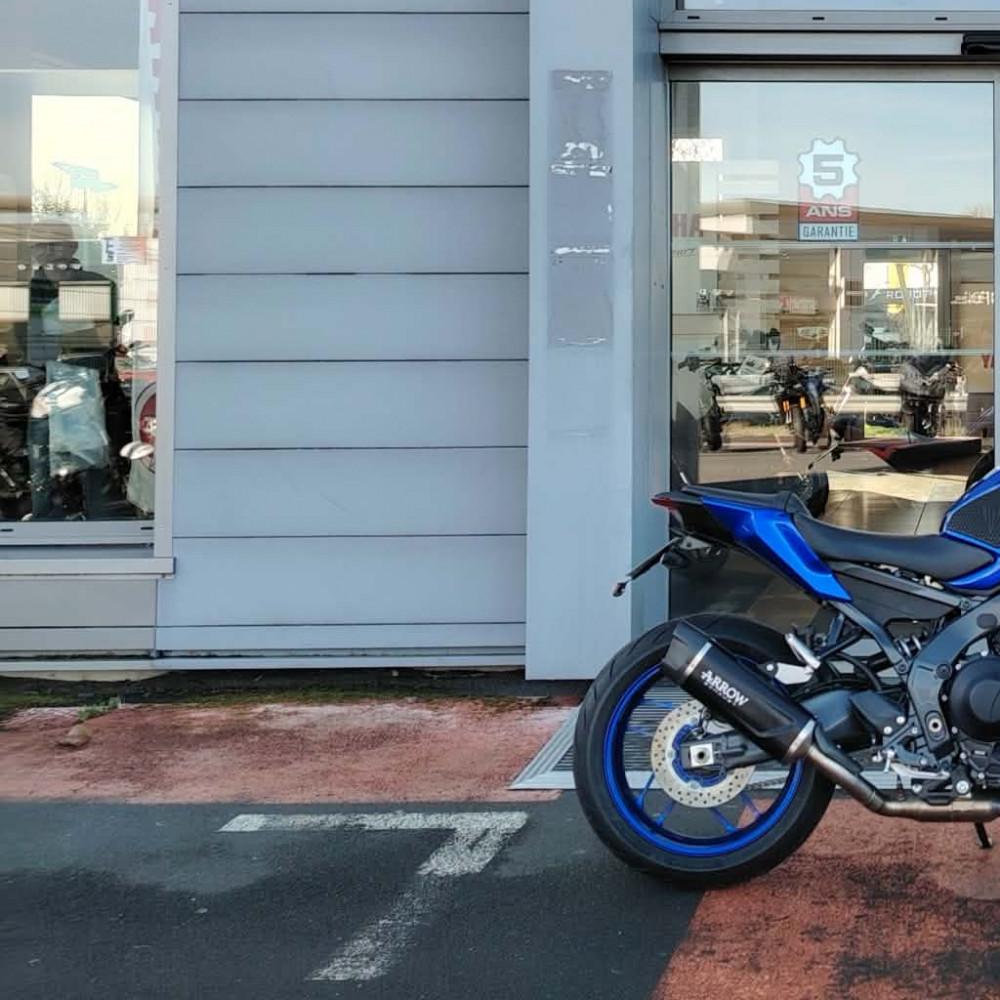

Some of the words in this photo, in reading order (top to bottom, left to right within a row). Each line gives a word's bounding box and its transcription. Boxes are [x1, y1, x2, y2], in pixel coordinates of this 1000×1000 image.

[813, 154, 844, 186] 5
[805, 205, 852, 218] ANS
[803, 226, 856, 238] GARANTIE
[701, 670, 750, 706] ARROW
